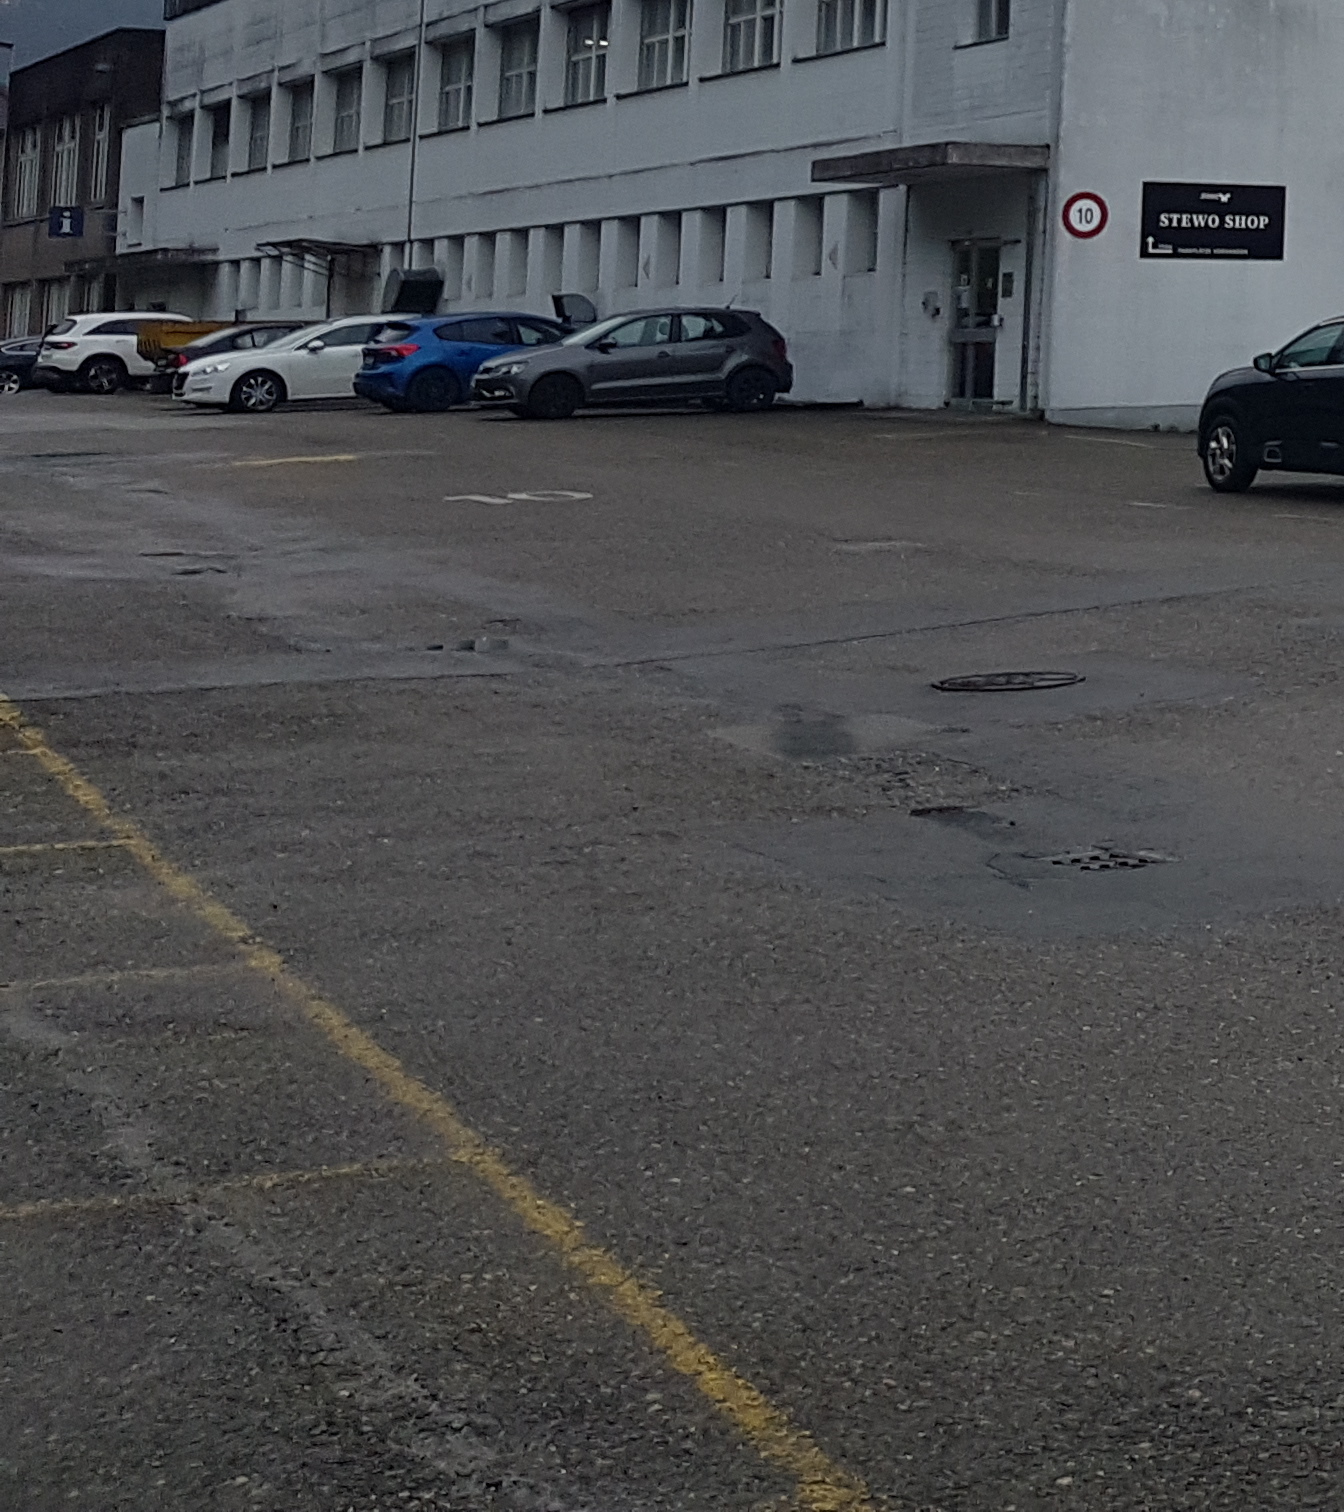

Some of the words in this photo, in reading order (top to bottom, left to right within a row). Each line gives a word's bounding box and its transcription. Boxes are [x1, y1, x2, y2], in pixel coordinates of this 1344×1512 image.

[1076, 207, 1094, 225] 10
[1159, 213, 1220, 228] STEWO
[1224, 214, 1269, 229] SHOP
